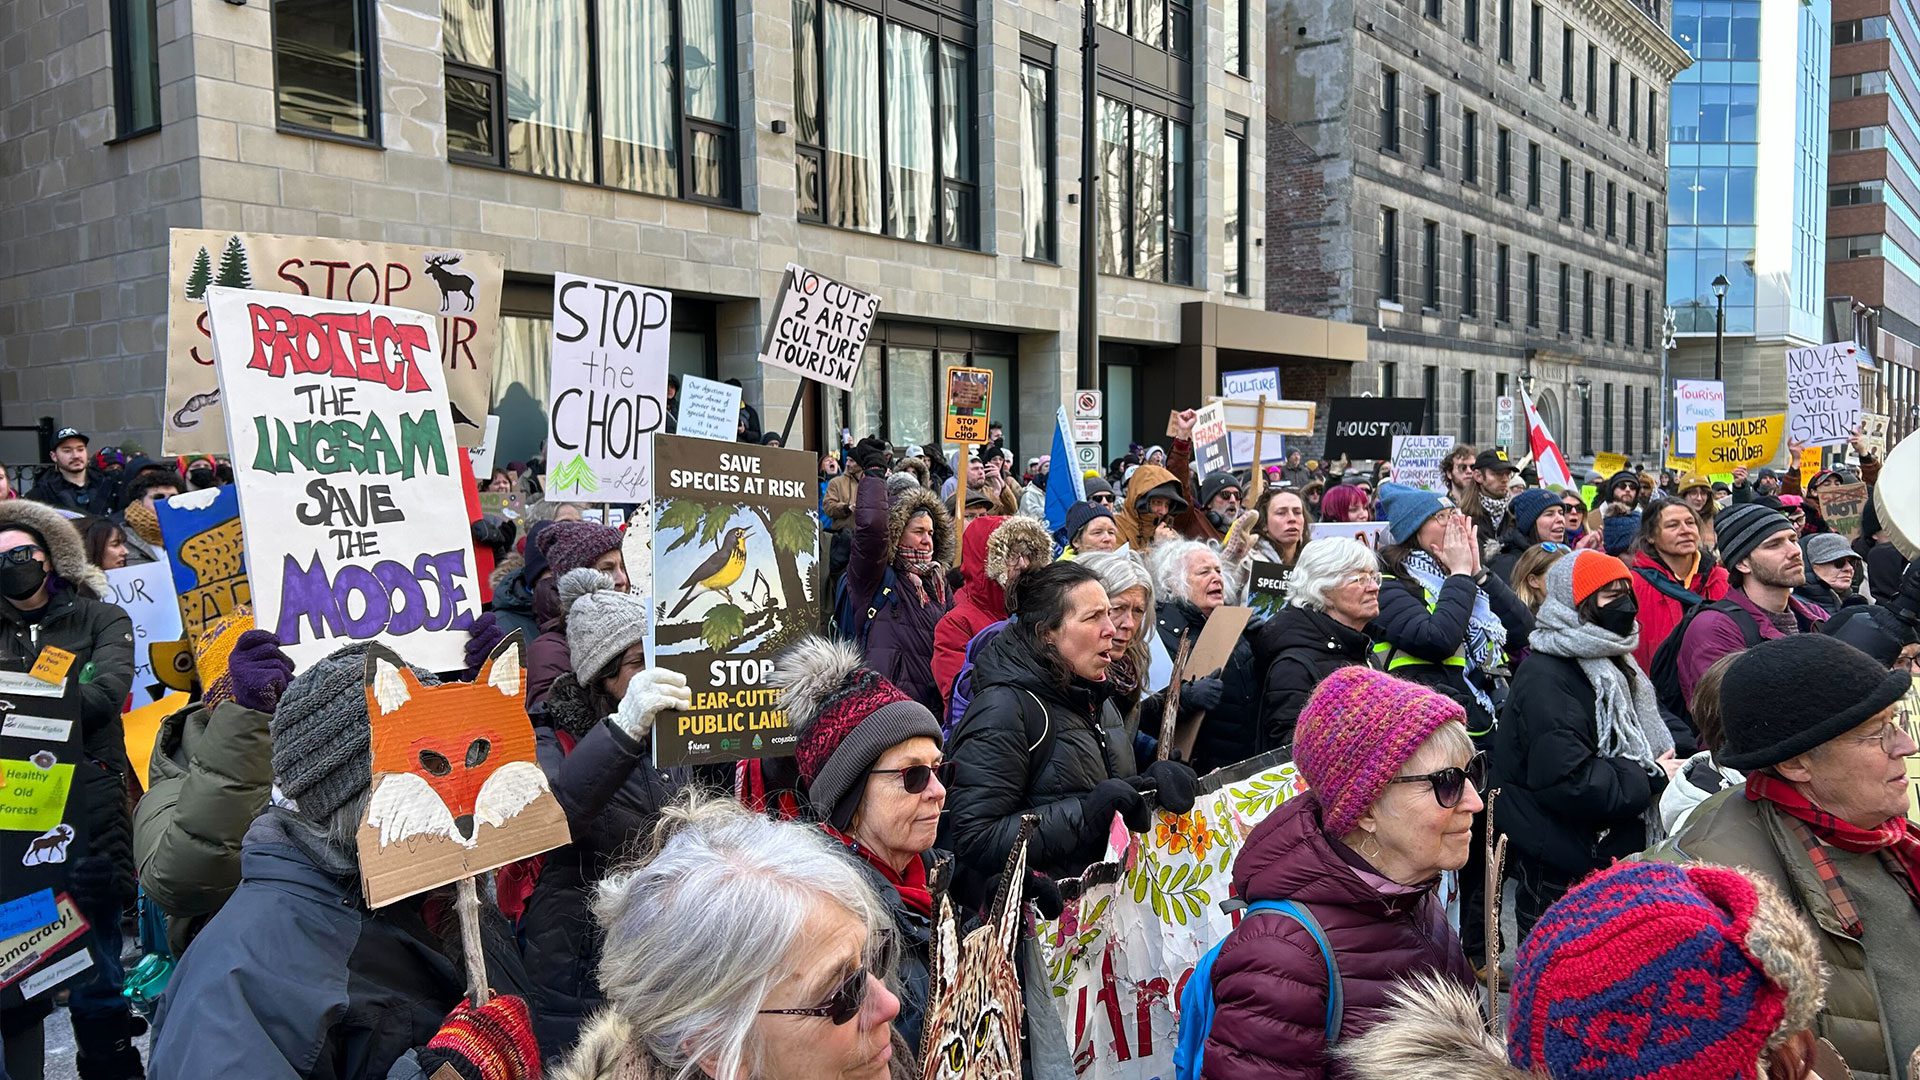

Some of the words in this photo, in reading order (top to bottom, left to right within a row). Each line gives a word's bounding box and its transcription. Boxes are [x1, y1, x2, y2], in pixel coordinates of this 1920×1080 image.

[277, 258, 412, 307] STOP
[789, 267, 819, 296] NO
[823, 281, 876, 319] CUTS
[556, 280, 667, 353] STOP
[795, 296, 809, 320] 2
[815, 307, 869, 342] ARTS
[246, 302, 432, 394] PROTECT
[780, 317, 860, 363] CULTURE
[582, 351, 634, 389] the
[775, 338, 852, 383] TOURISM
[1788, 346, 1846, 373] NOVA
[1228, 376, 1275, 394] CULTURE
[1787, 366, 1848, 390] SCOTIA
[294, 385, 361, 416] THE
[1803, 400, 1838, 413] WILL
[551, 387, 662, 461] CHOP
[956, 417, 978, 425] STOP
[960, 424, 973, 432] the
[1195, 420, 1225, 448] FRACK
[1336, 421, 1412, 437] HOUSTON
[1711, 418, 1768, 439] SHOULDER
[1791, 409, 1858, 442] STRIKE
[253, 409, 449, 481] INGRAM
[954, 431, 978, 439] CHOP
[1406, 437, 1449, 447] CULTURE
[1734, 437, 1748, 447] TO
[719, 452, 761, 474] SAVE
[1205, 443, 1219, 458] OUR
[1709, 444, 1763, 463] SHOULDER
[1203, 456, 1225, 474] WATER
[614, 466, 648, 497] Life
[670, 469, 740, 493] SPECIES
[743, 477, 764, 495] AT
[768, 479, 806, 499] RISK
[295, 478, 405, 527] SAVE
[1826, 500, 1861, 516] NOT
[329, 530, 380, 560] THE
[276, 548, 475, 646] MOOSE
[709, 658, 775, 688] STOP
[678, 712, 745, 736] PUBLIC
[693, 743, 710, 751] Nature
[6, 769, 49, 783] Healthy
[13, 787, 33, 797] Old
[0, 803, 39, 815] Forests
[0, 908, 74, 968] emocracy!
